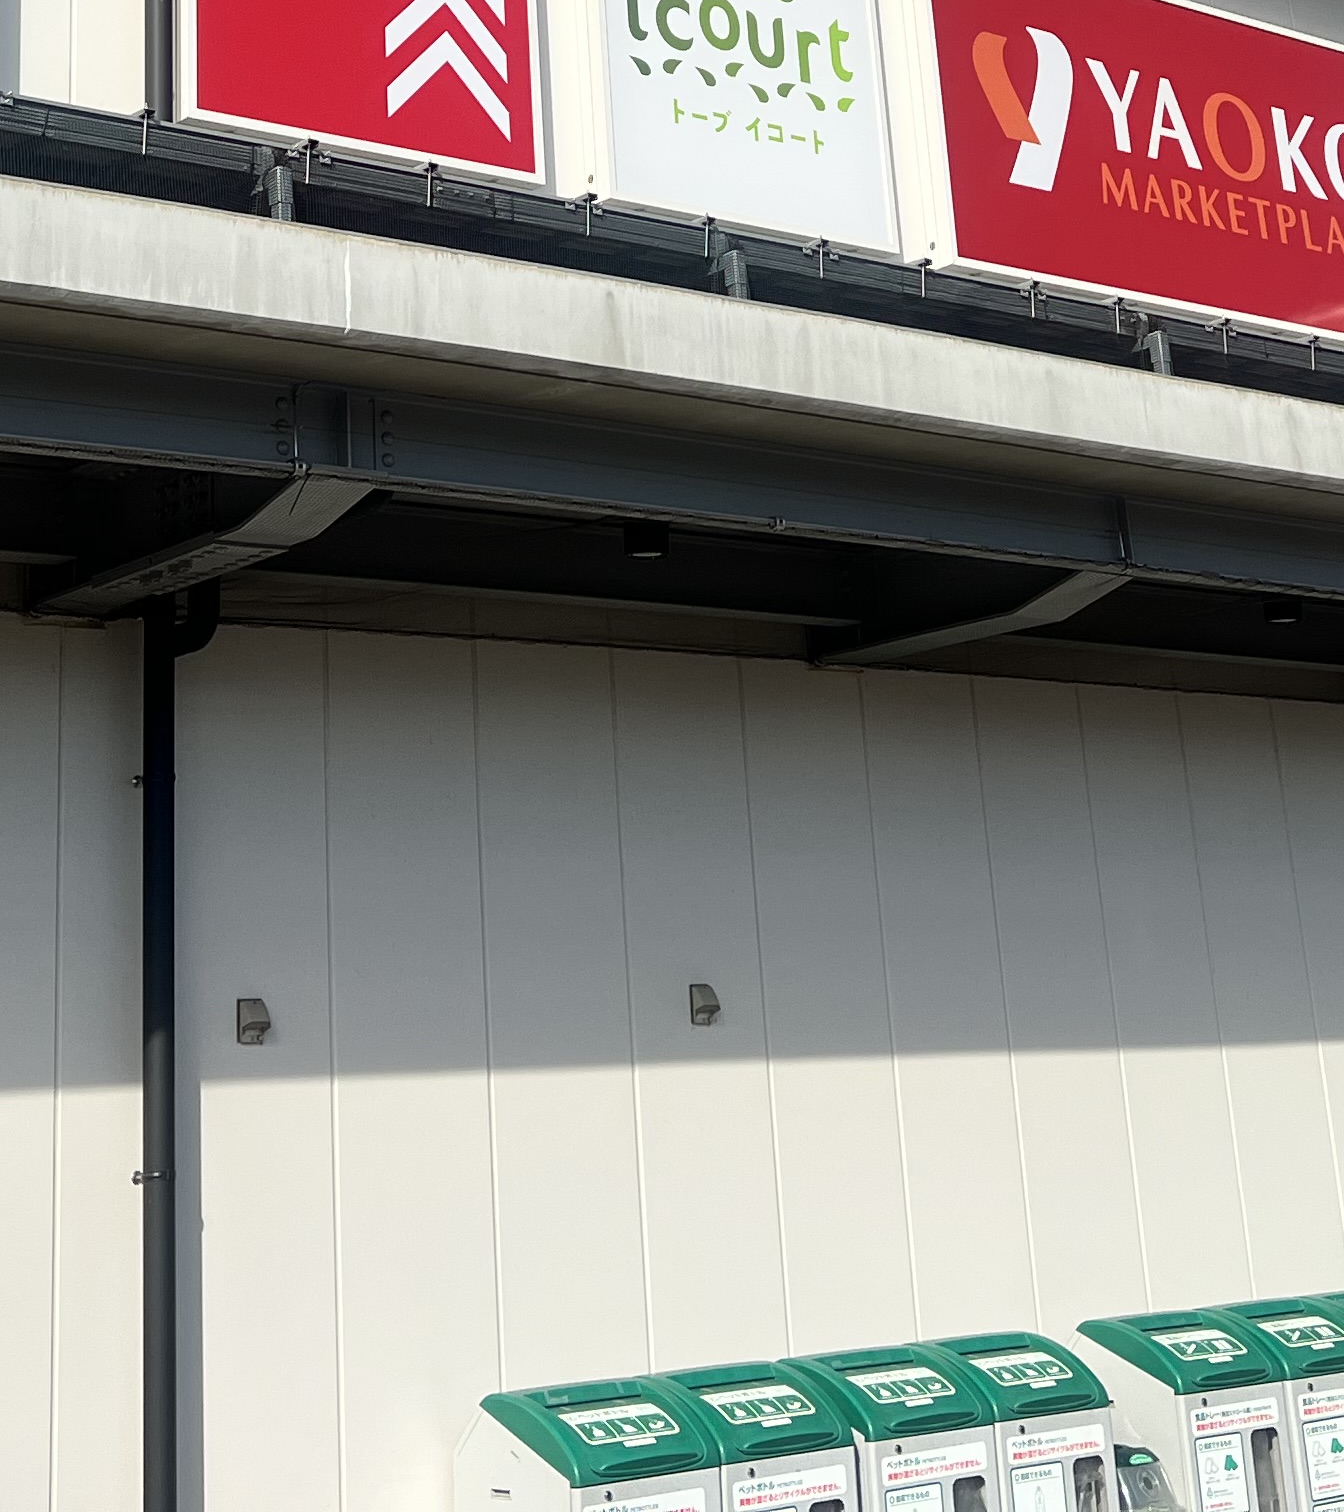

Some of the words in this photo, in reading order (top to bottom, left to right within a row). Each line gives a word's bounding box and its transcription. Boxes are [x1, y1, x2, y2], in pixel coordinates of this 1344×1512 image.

[738, 1480, 775, 1494] ペットボトル
